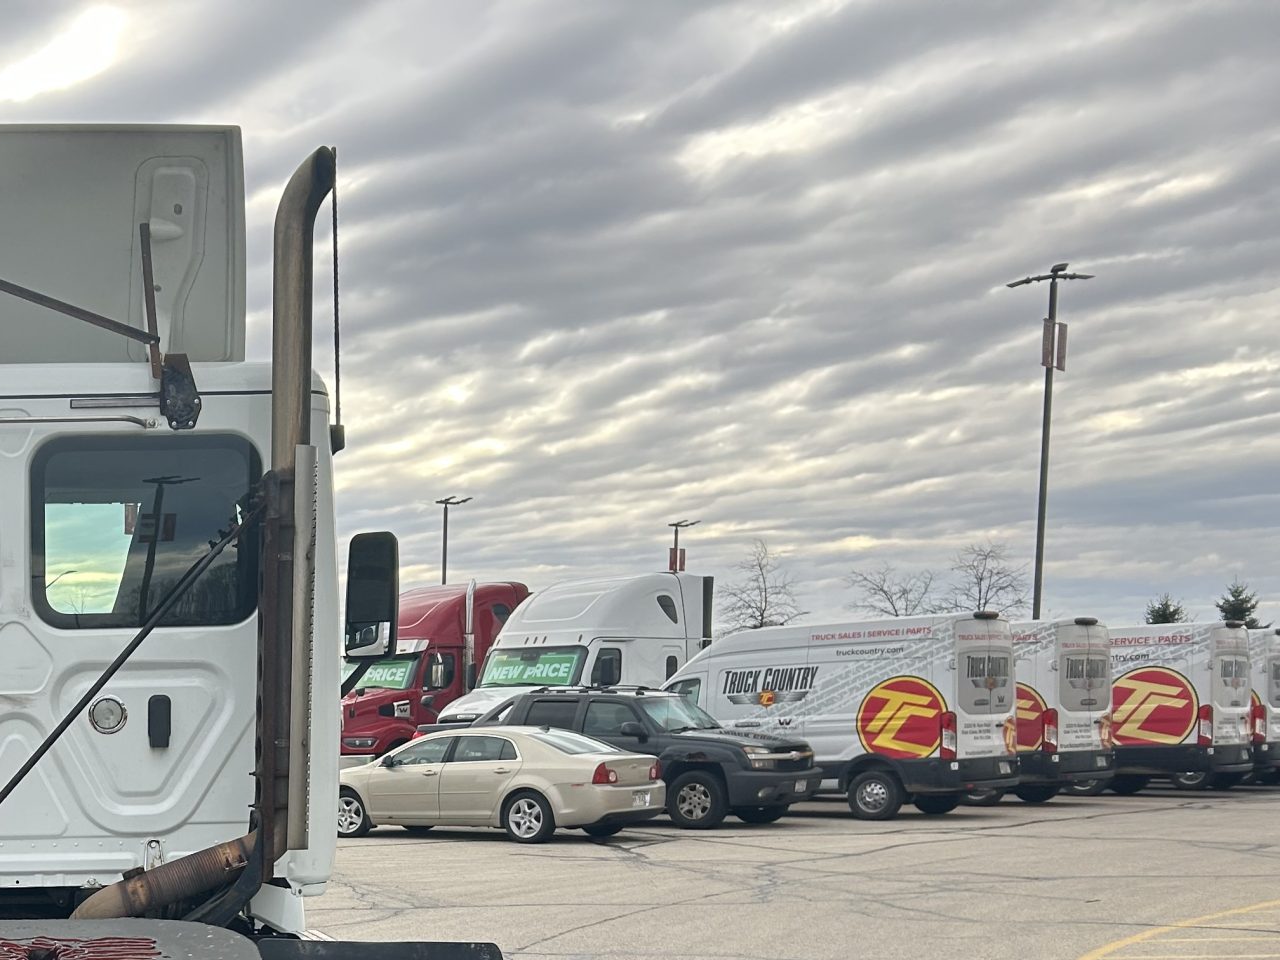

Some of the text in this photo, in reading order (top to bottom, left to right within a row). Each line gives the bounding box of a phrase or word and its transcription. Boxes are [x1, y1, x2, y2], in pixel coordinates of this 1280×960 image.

[811, 626, 932, 641] TRUCK SALES SERVICE PARTS
[1158, 635, 1191, 644] PARTS
[836, 646, 904, 656] truckcountry.com
[364, 667, 406, 682] PRICE
[489, 663, 571, 680] NEW PRICE
[722, 666, 819, 695] TRUCK COUNTRY
